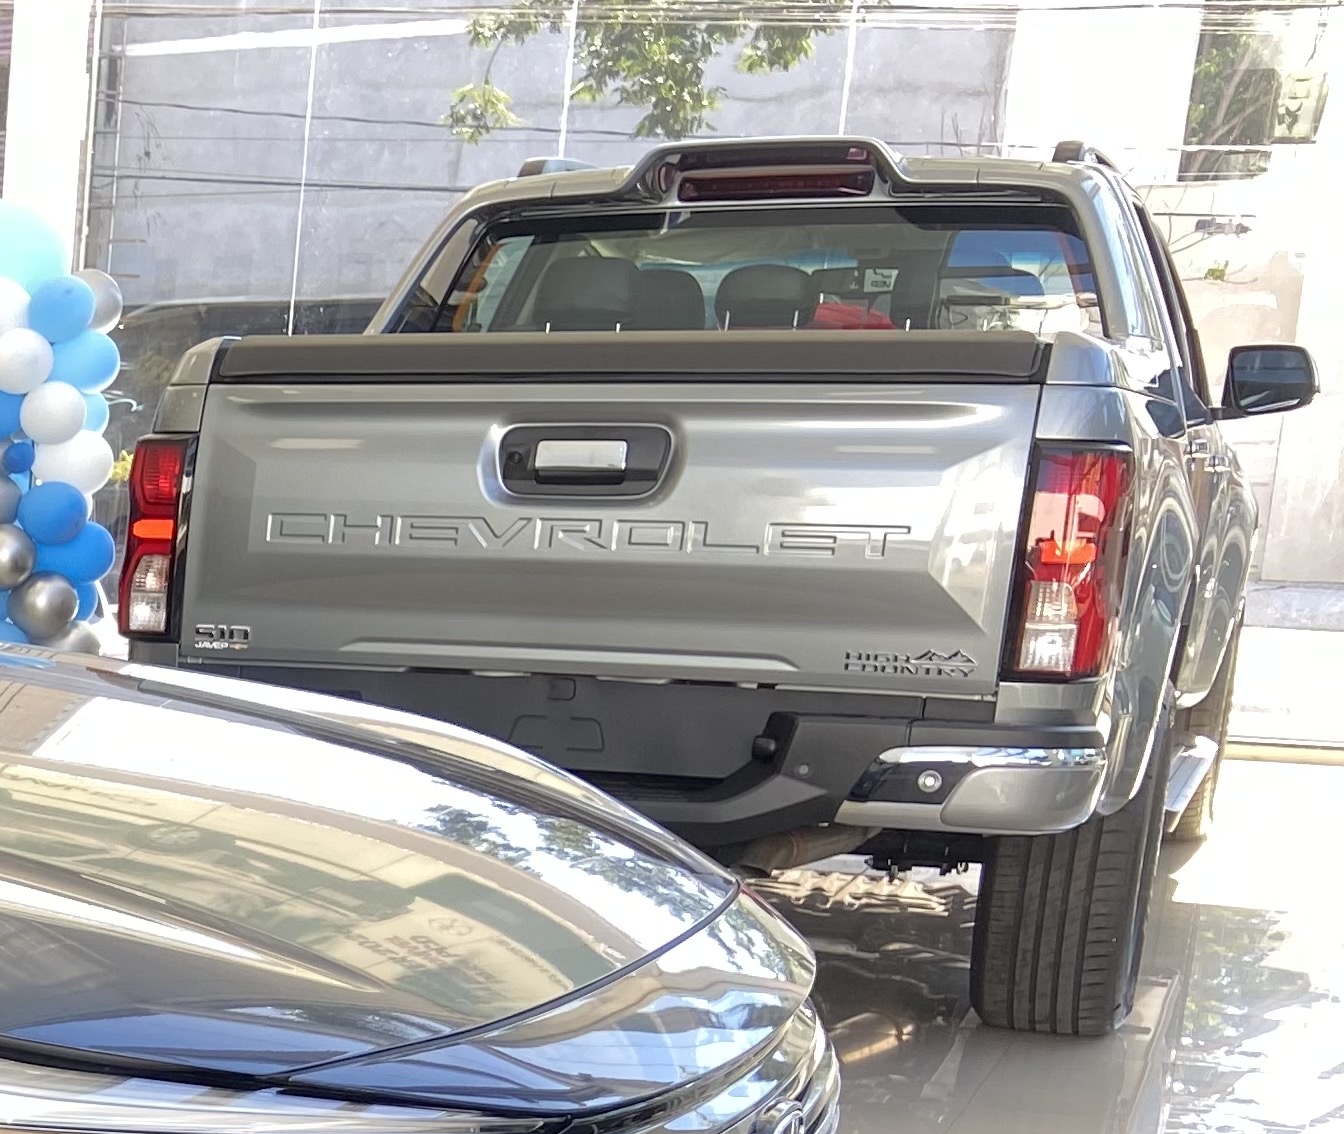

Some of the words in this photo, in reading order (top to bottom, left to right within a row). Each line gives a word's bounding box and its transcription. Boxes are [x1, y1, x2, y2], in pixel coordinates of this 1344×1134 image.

[266, 512, 911, 559] CHEVROLET
[195, 624, 251, 642] S10
[845, 651, 910, 663] HIGH
[844, 663, 975, 677] COUNTRY
